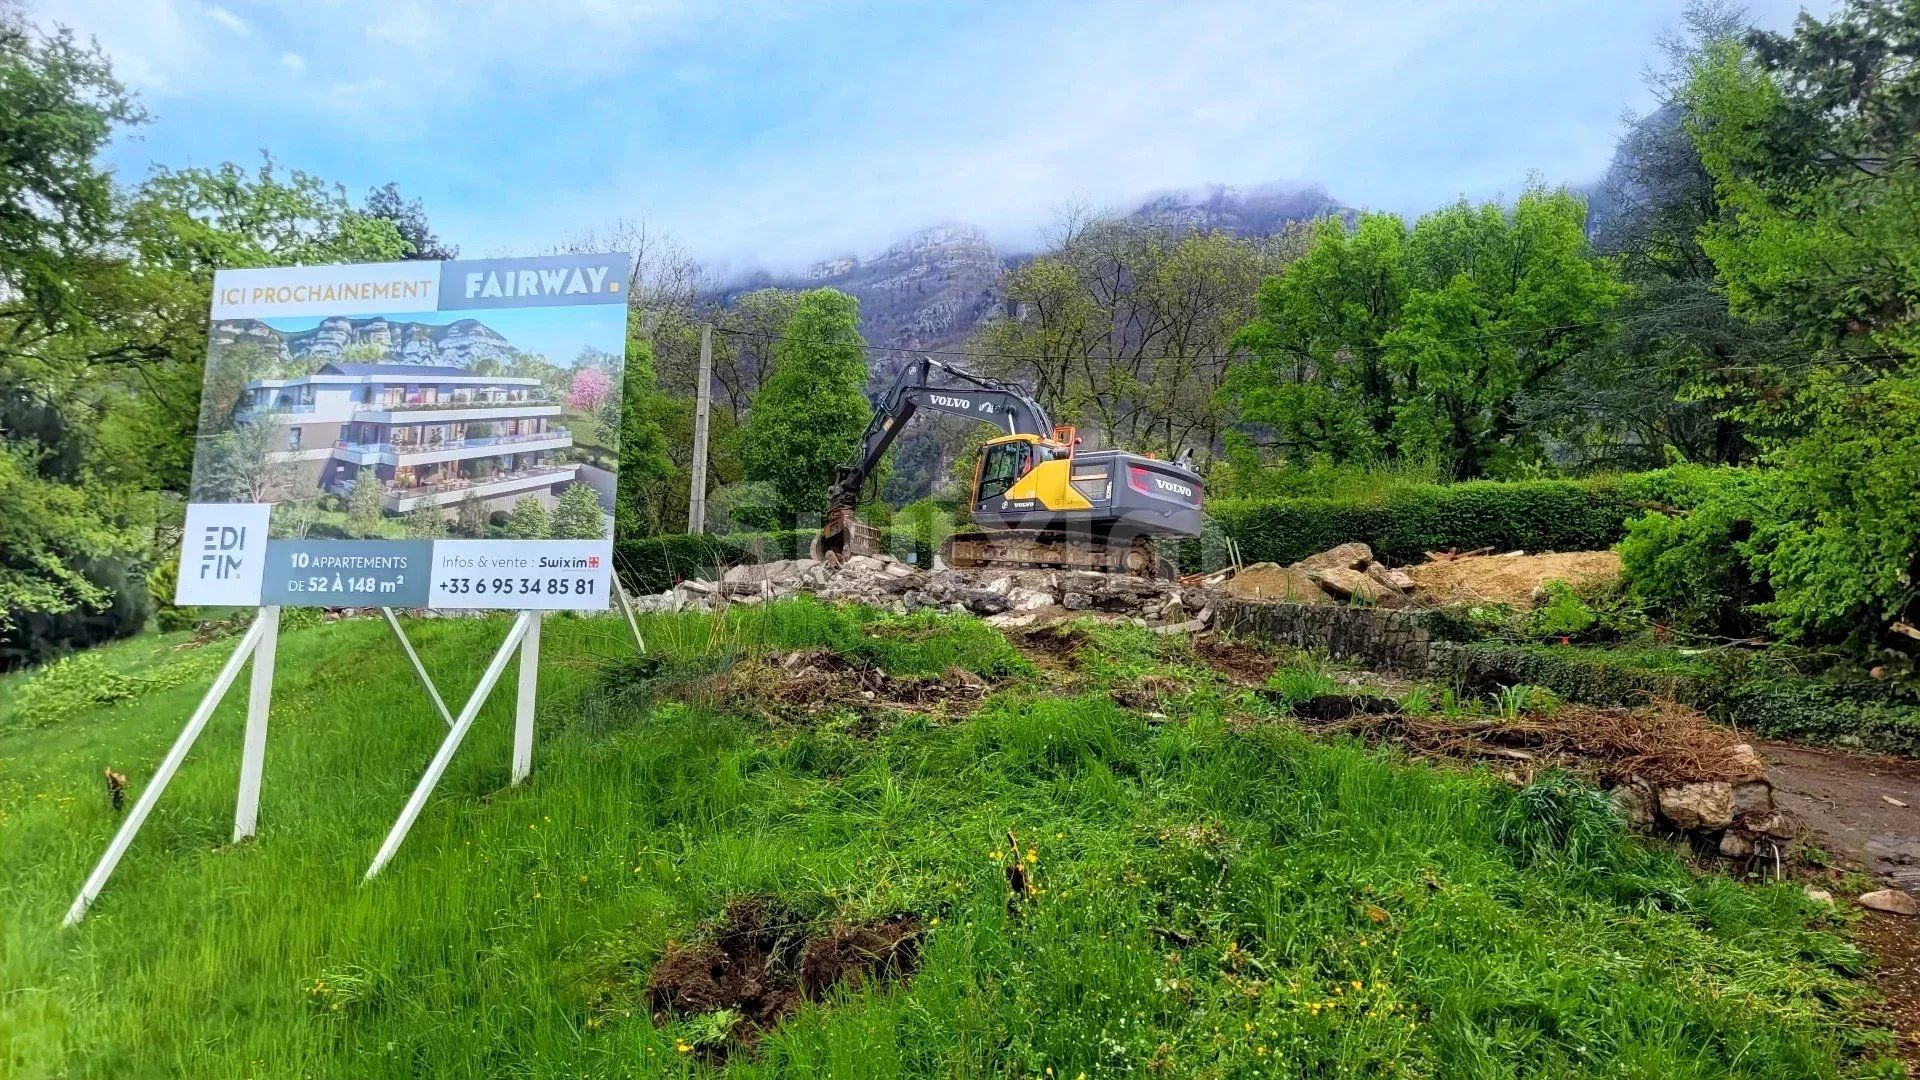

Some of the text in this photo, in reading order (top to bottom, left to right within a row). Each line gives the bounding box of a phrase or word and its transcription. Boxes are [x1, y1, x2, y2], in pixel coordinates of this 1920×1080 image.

[220, 280, 433, 305] ICI PROCHAINEMENT
[929, 394, 971, 409] VOLVO
[1155, 479, 1192, 497] VOLVO
[204, 526, 247, 551] EDI
[290, 552, 408, 569] 10 APPARTEMENTS
[442, 555, 474, 569] Infos
[477, 556, 488, 569] &
[491, 558, 528, 569] vente
[538, 556, 588, 569] Swixim
[288, 572, 404, 593] DE 52 À 148 m²
[439, 578, 595, 595] +33 6 95 34 85 81
